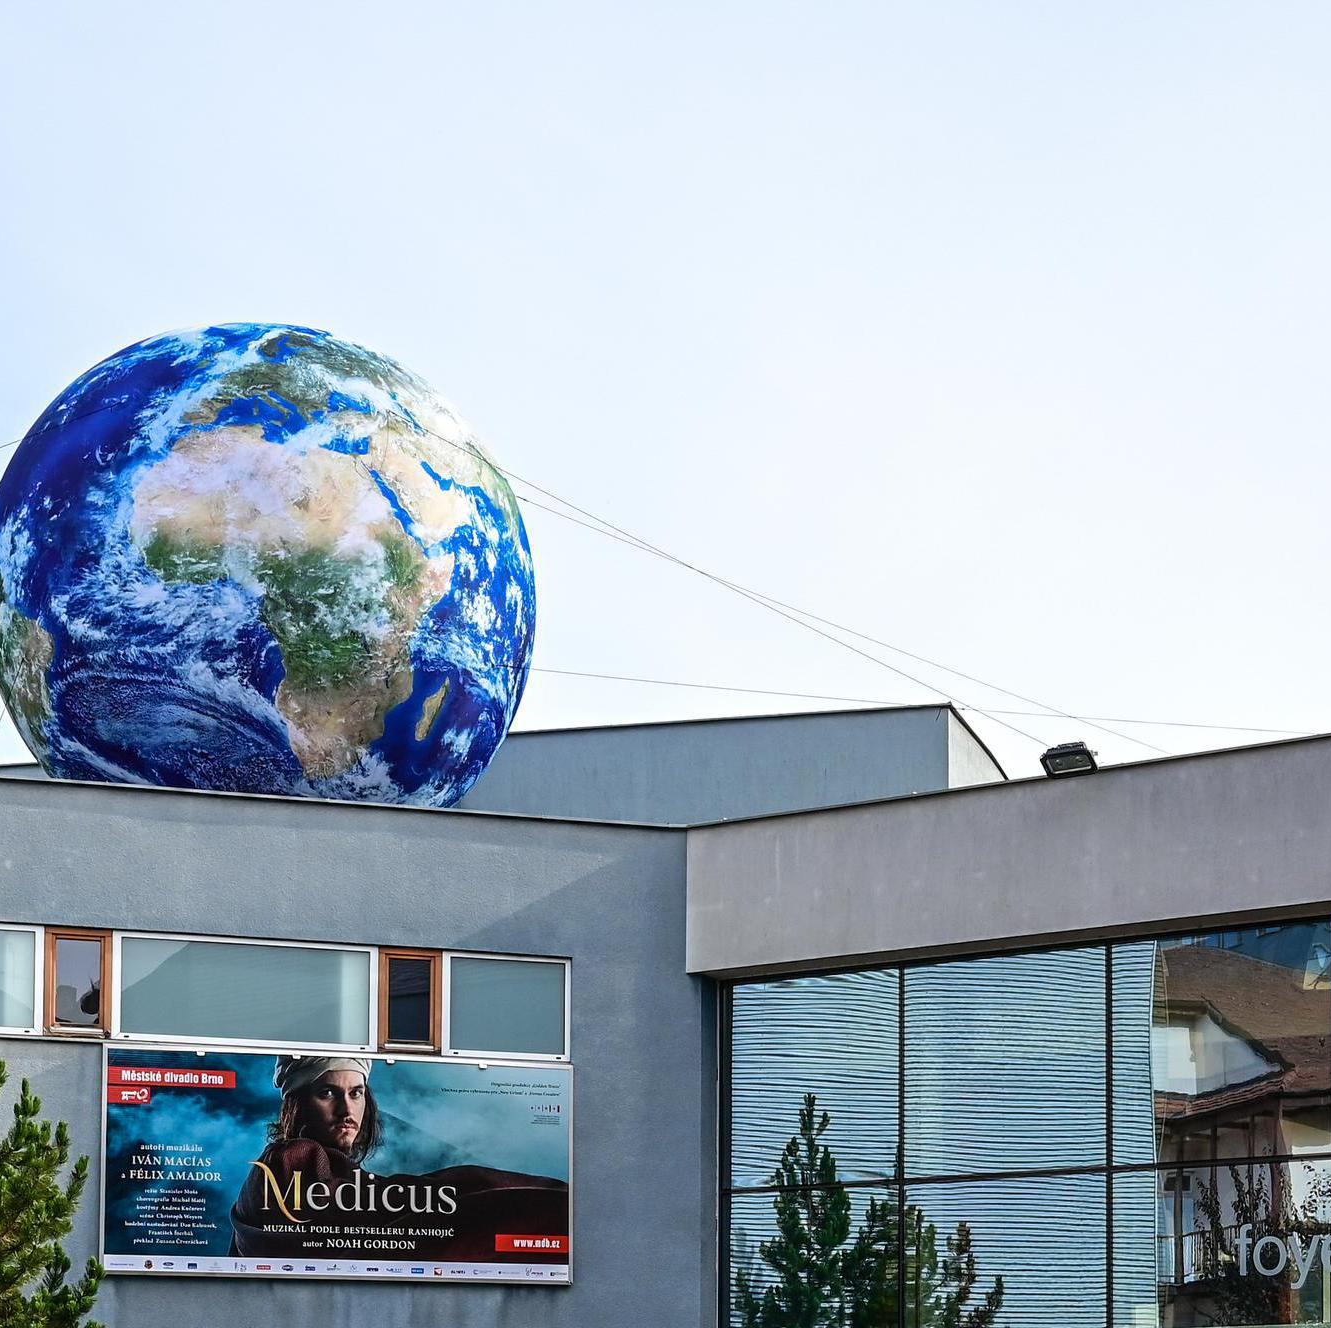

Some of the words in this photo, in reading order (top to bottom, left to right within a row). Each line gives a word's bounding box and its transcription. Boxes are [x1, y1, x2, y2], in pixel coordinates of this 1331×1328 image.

[121, 1069, 162, 1082] Městské
[164, 1072, 199, 1084] divadlo
[201, 1073, 224, 1085] Brno
[140, 1143, 165, 1151] autoři
[166, 1144, 203, 1152] muzikálu
[132, 1154, 162, 1166] IVÁN
[164, 1155, 212, 1167] MACÍAS
[129, 1168, 165, 1180] FÉLIX
[166, 1171, 222, 1182] AMADOR
[249, 1161, 458, 1224] Medicus
[262, 1223, 307, 1234] MUZIKÁL
[310, 1225, 341, 1235] PODLE
[344, 1226, 405, 1236] BESTSELLERU
[408, 1227, 455, 1239] RANHOJIČ
[302, 1240, 324, 1248] autor
[326, 1238, 361, 1249] NOAH
[364, 1239, 416, 1250] GORDON
[513, 1237, 560, 1249] www.mdb.cz
